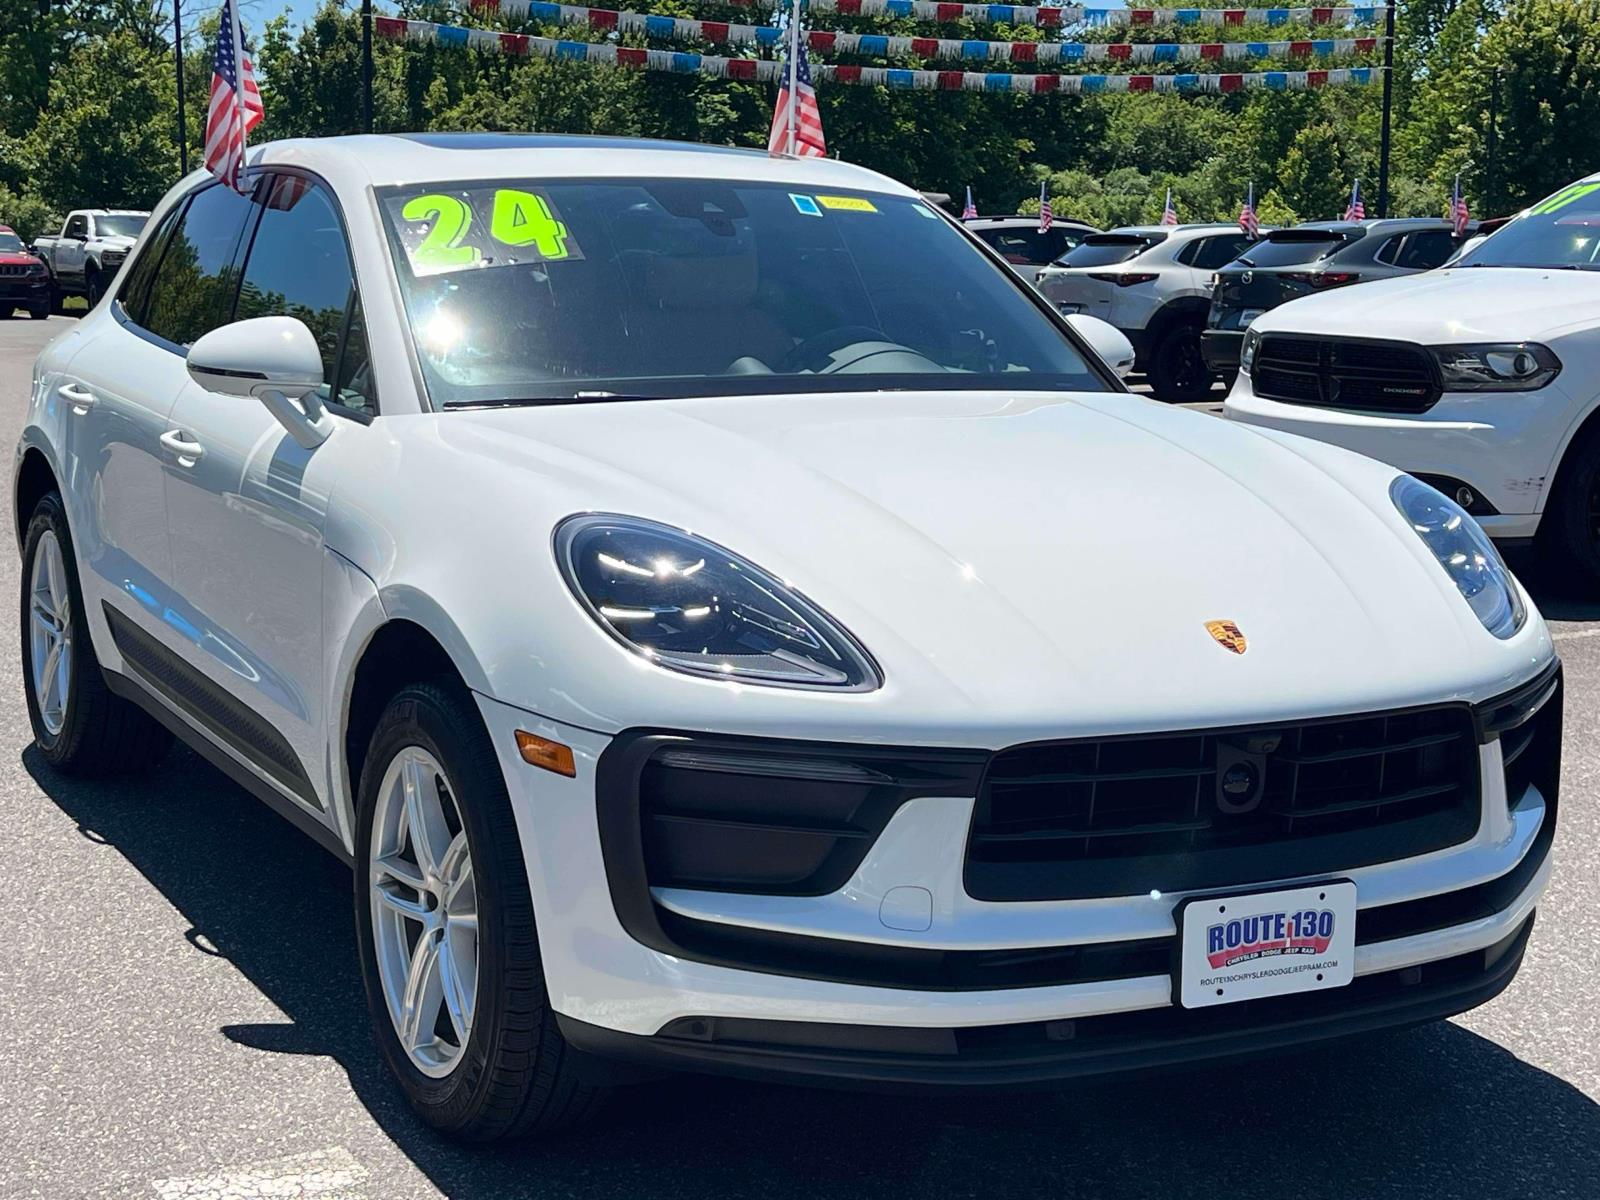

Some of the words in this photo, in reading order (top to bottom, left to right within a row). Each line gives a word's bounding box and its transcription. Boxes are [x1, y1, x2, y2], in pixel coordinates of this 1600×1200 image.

[402, 189, 568, 262] 24
[1209, 913, 1286, 953] ROUTE
[1291, 910, 1334, 938] 130
[1200, 960, 1338, 986] ROUTE130CHRYSLERDODGEJEEPRAM.COM
[1226, 953, 1259, 966] CHRYSLER
[1261, 949, 1281, 957] DODGE
